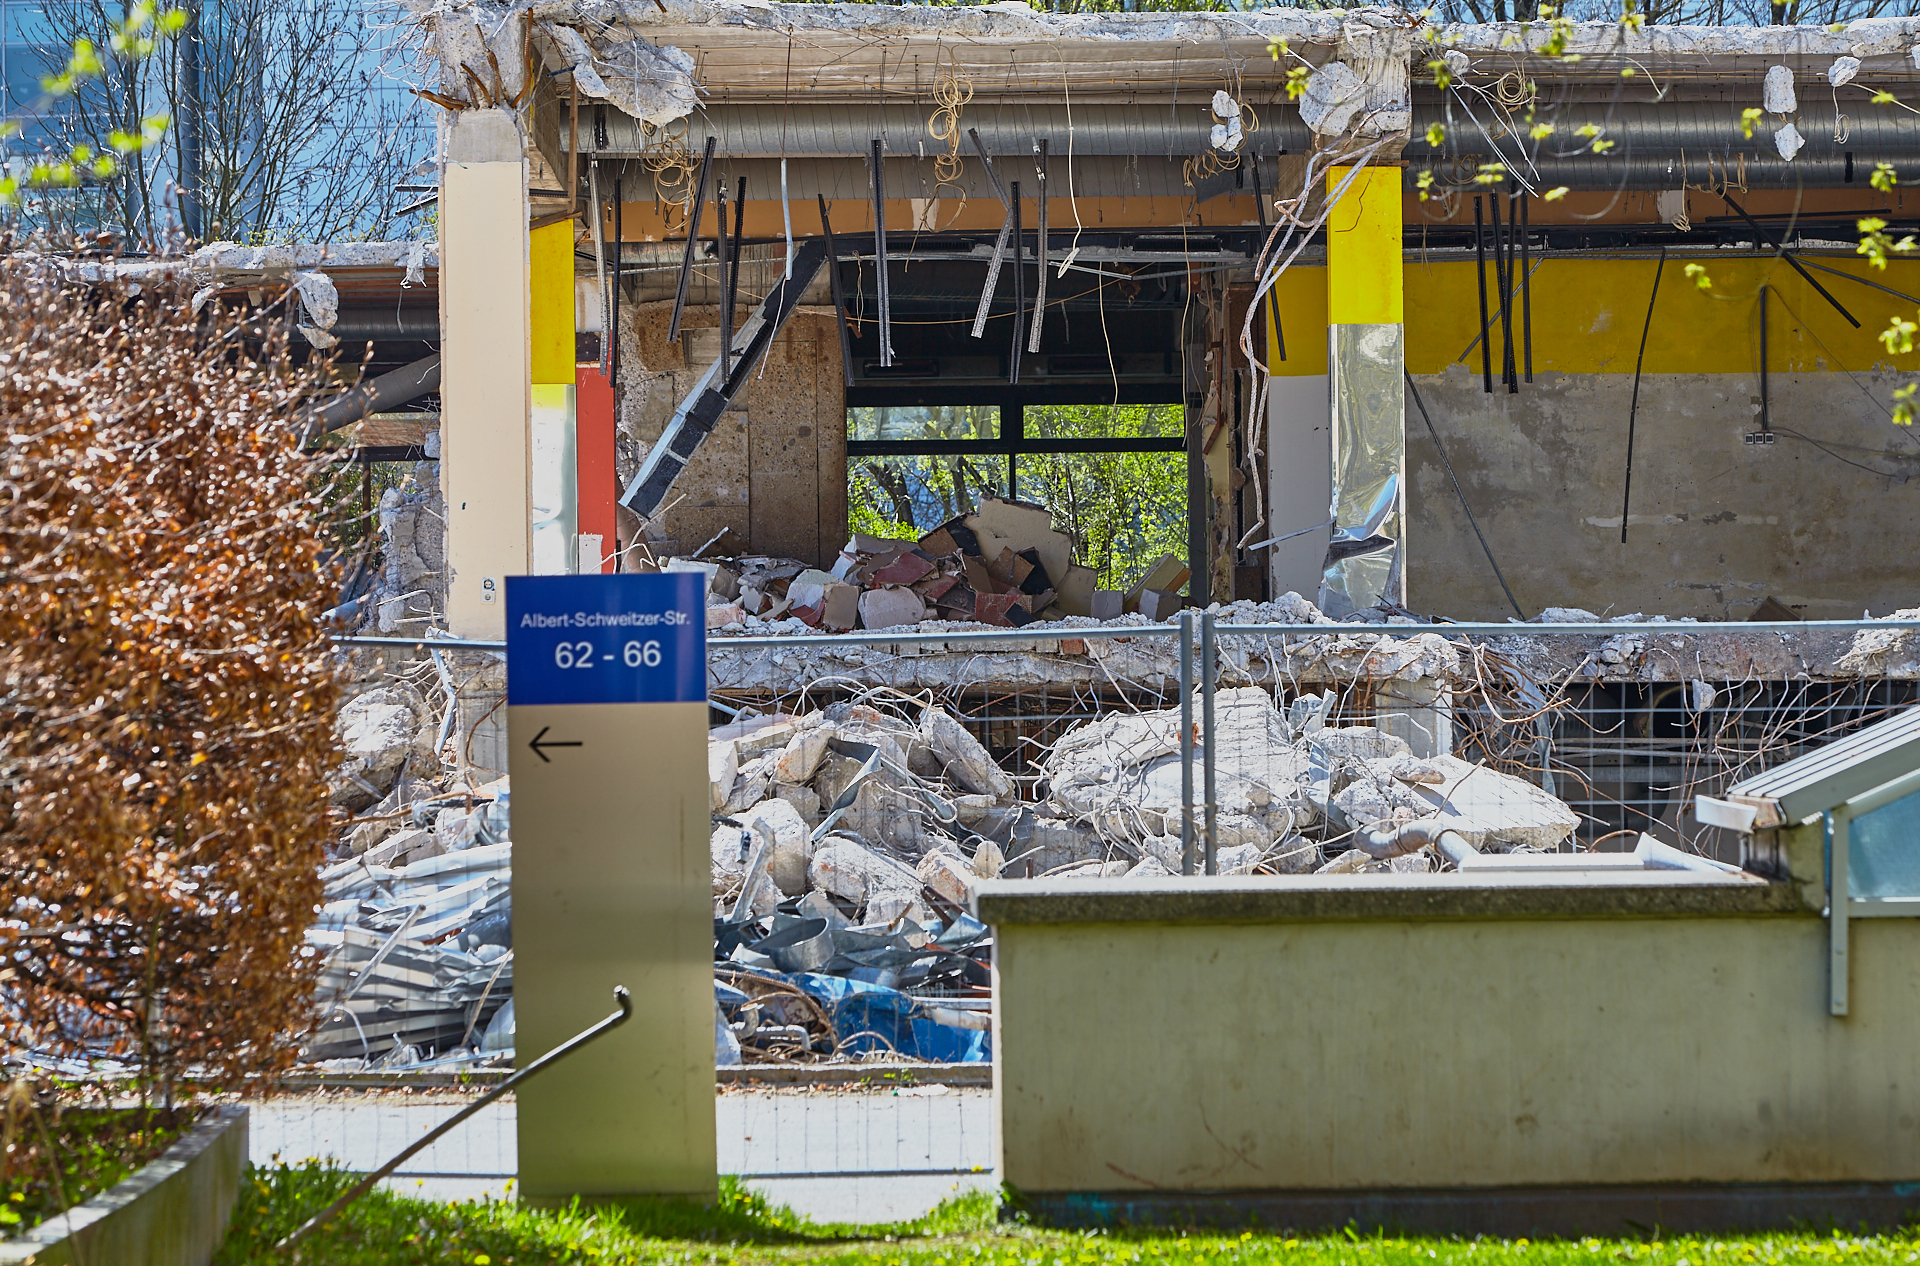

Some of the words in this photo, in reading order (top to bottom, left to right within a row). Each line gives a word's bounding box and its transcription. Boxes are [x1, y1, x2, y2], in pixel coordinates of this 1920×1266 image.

[520, 610, 691, 628] Albert-Schweitzer-Str.
[555, 641, 594, 669] 62
[623, 639, 662, 668] 66
